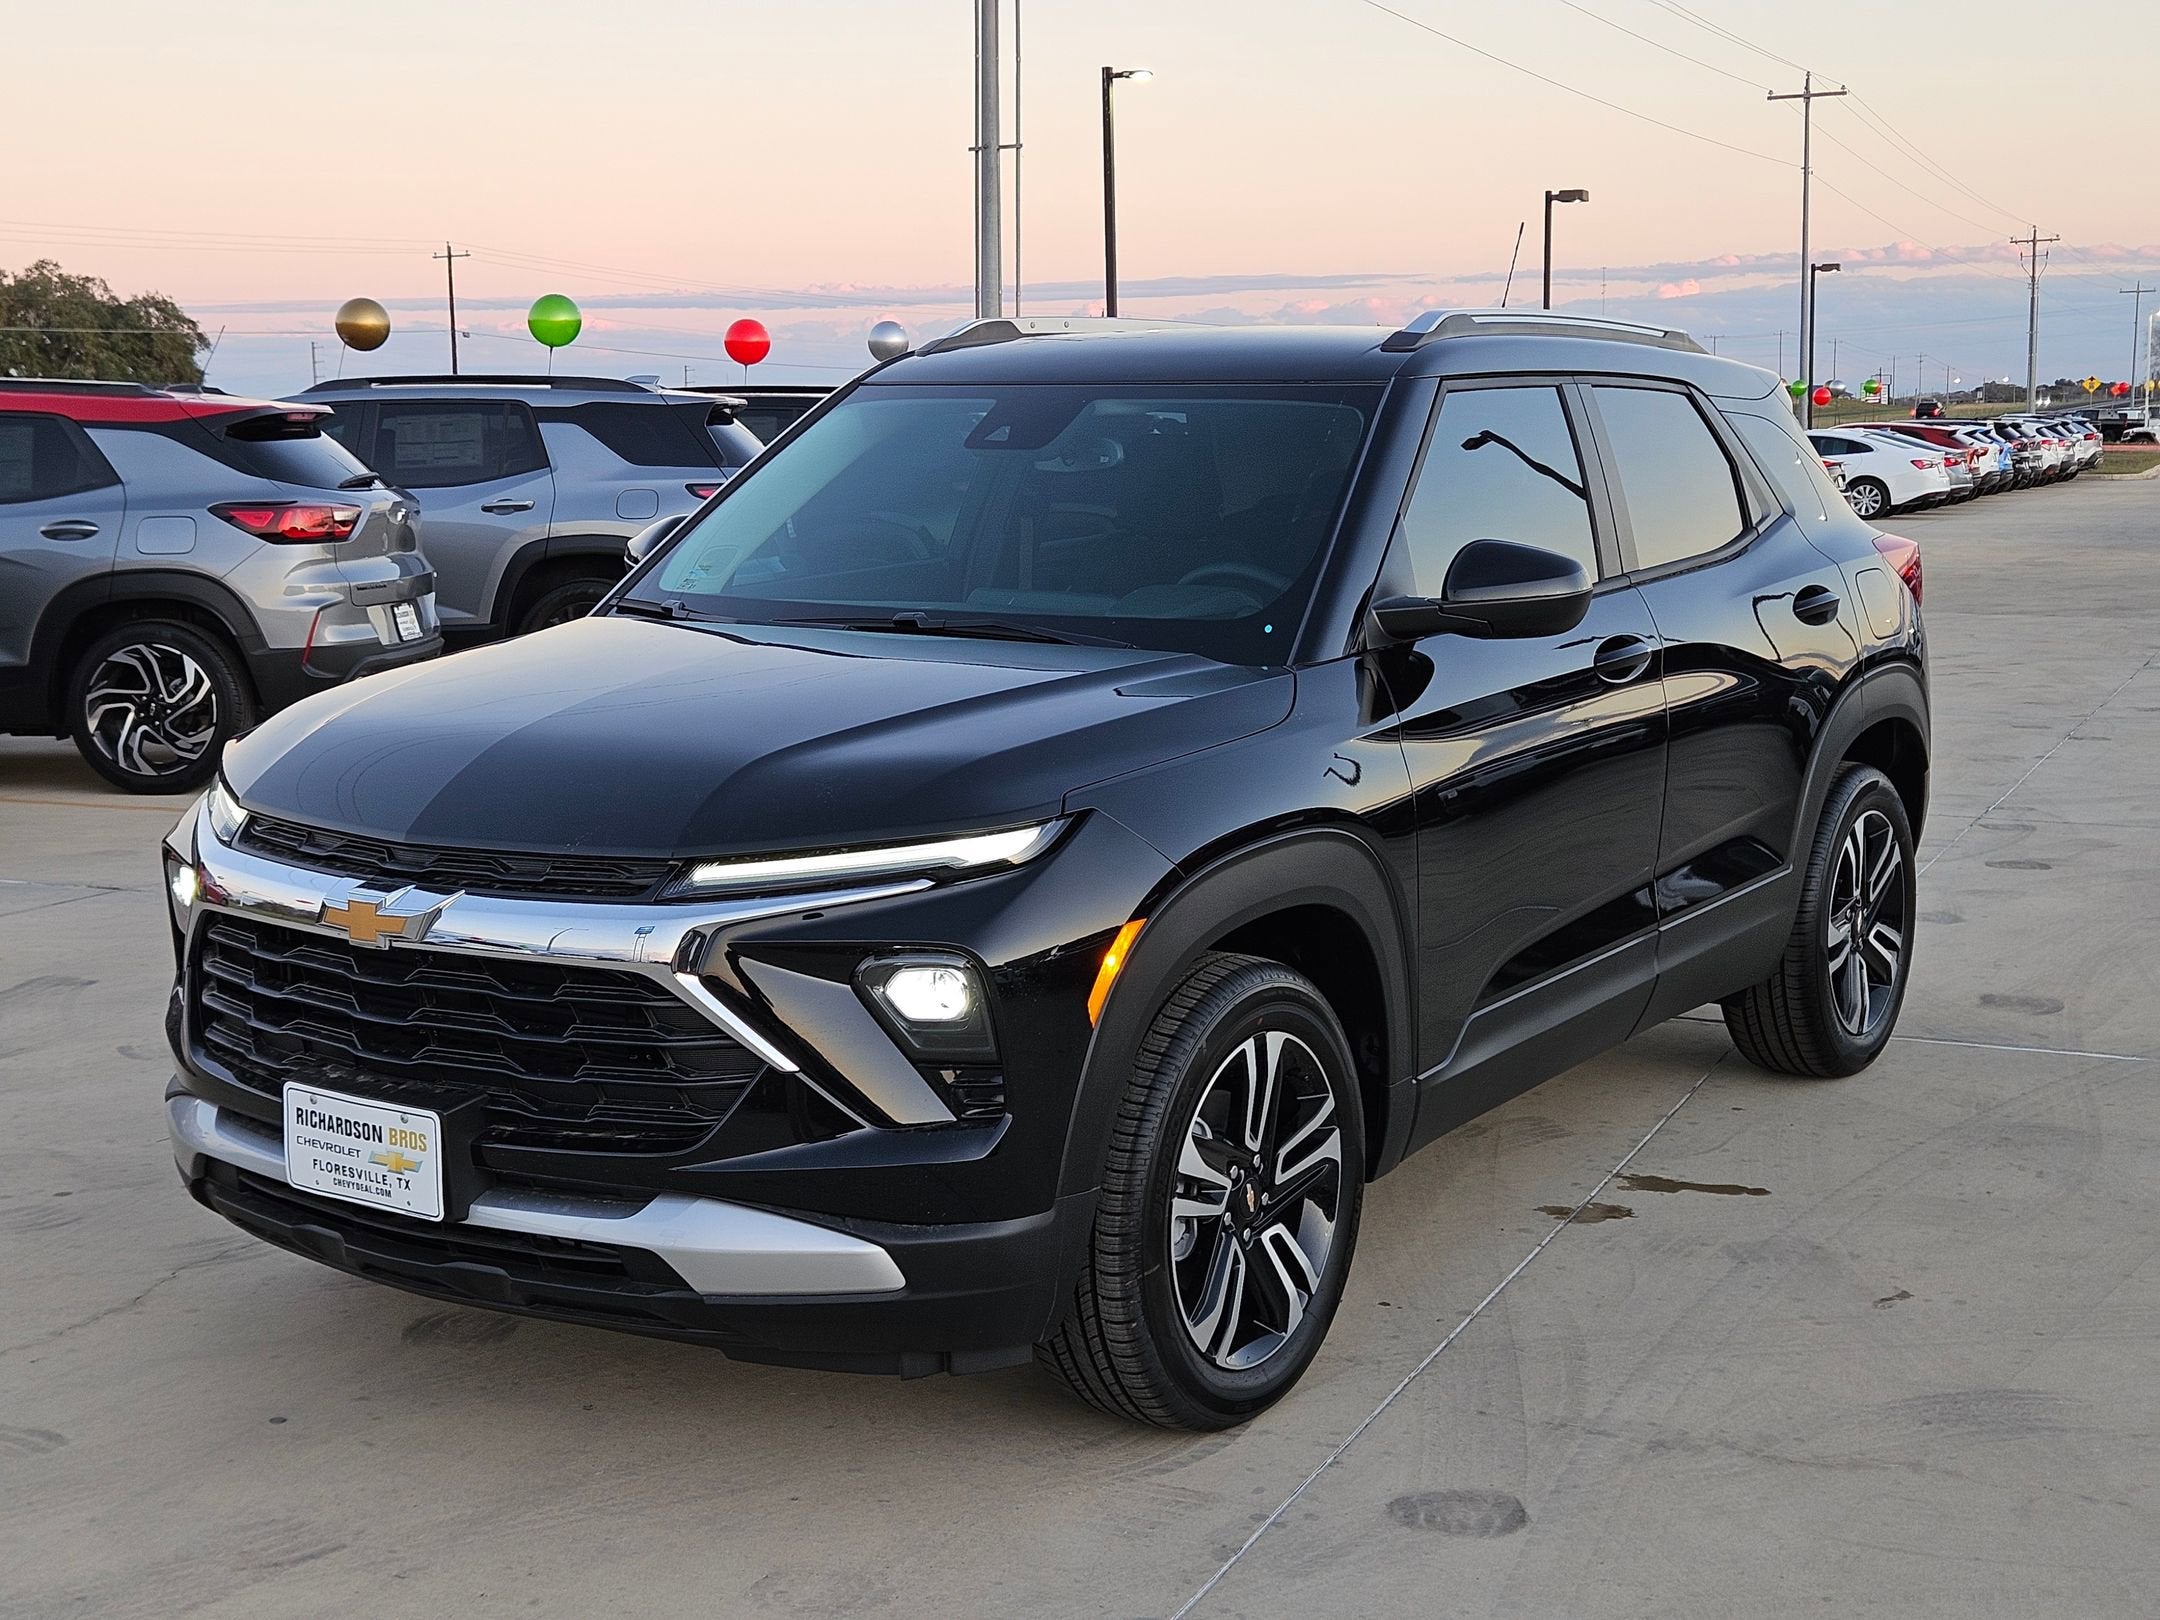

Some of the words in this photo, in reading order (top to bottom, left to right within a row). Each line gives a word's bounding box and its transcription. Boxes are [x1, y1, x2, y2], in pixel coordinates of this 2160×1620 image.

[296, 1107, 383, 1143] RICHARDSON
[388, 1127, 428, 1152] BROS
[296, 1135, 361, 1158] CHEVROLET
[312, 1158, 393, 1188] FLORESVILLE,
[396, 1177, 411, 1191] TX
[333, 1177, 392, 1198] CHEVYDEAL.COM
